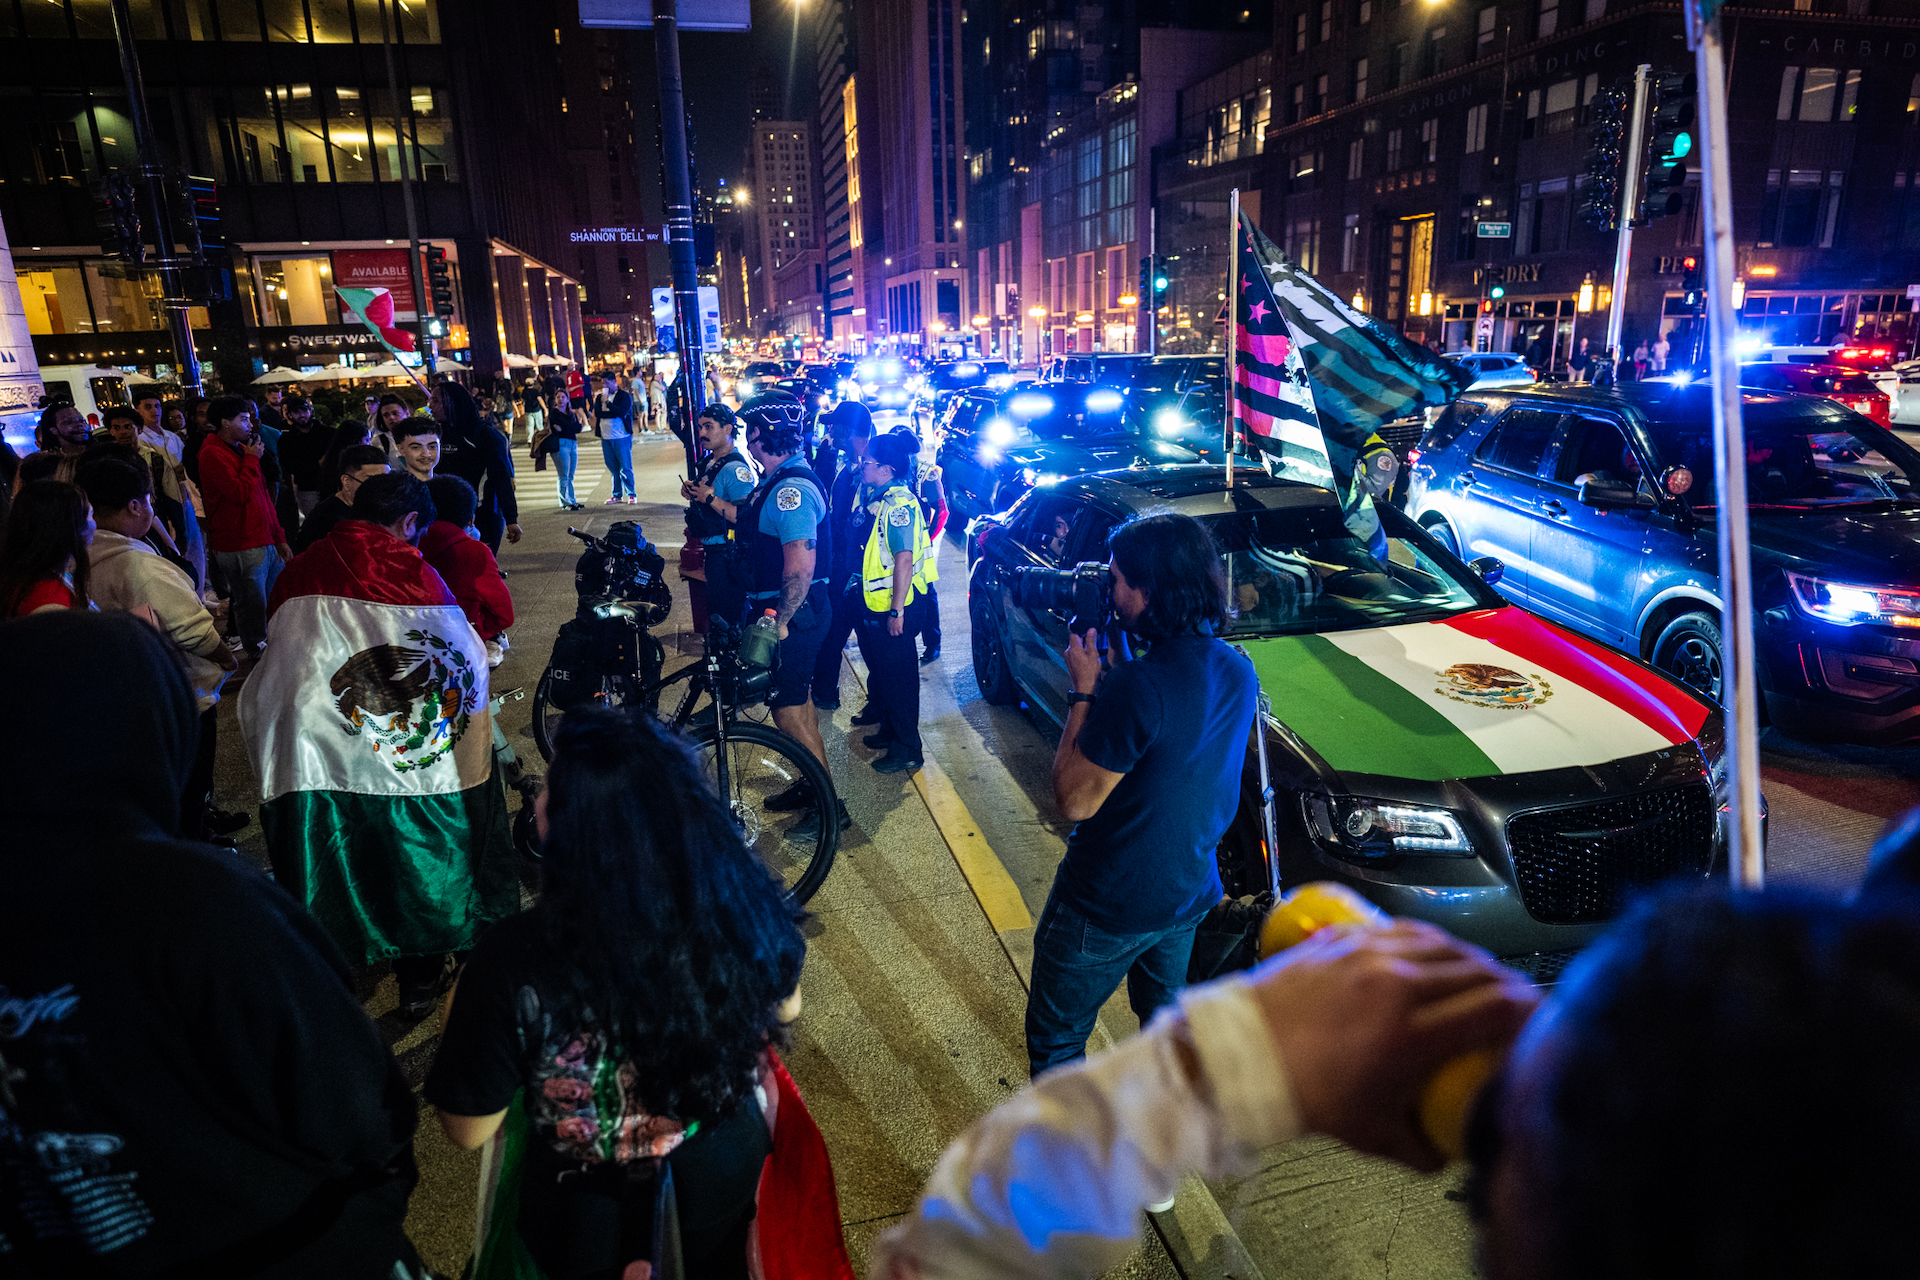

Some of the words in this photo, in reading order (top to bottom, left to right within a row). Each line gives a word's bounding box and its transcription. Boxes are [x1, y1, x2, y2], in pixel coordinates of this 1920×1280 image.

[1784, 36, 1917, 58] CARBID
[570, 232, 616, 242] SHANNON
[620, 232, 644, 242] DELL
[352, 266, 408, 277] AVAILABLE
[1473, 263, 1542, 285] PDRY
[288, 333, 380, 346] SWEETWAT
[548, 668, 571, 682] ICE
